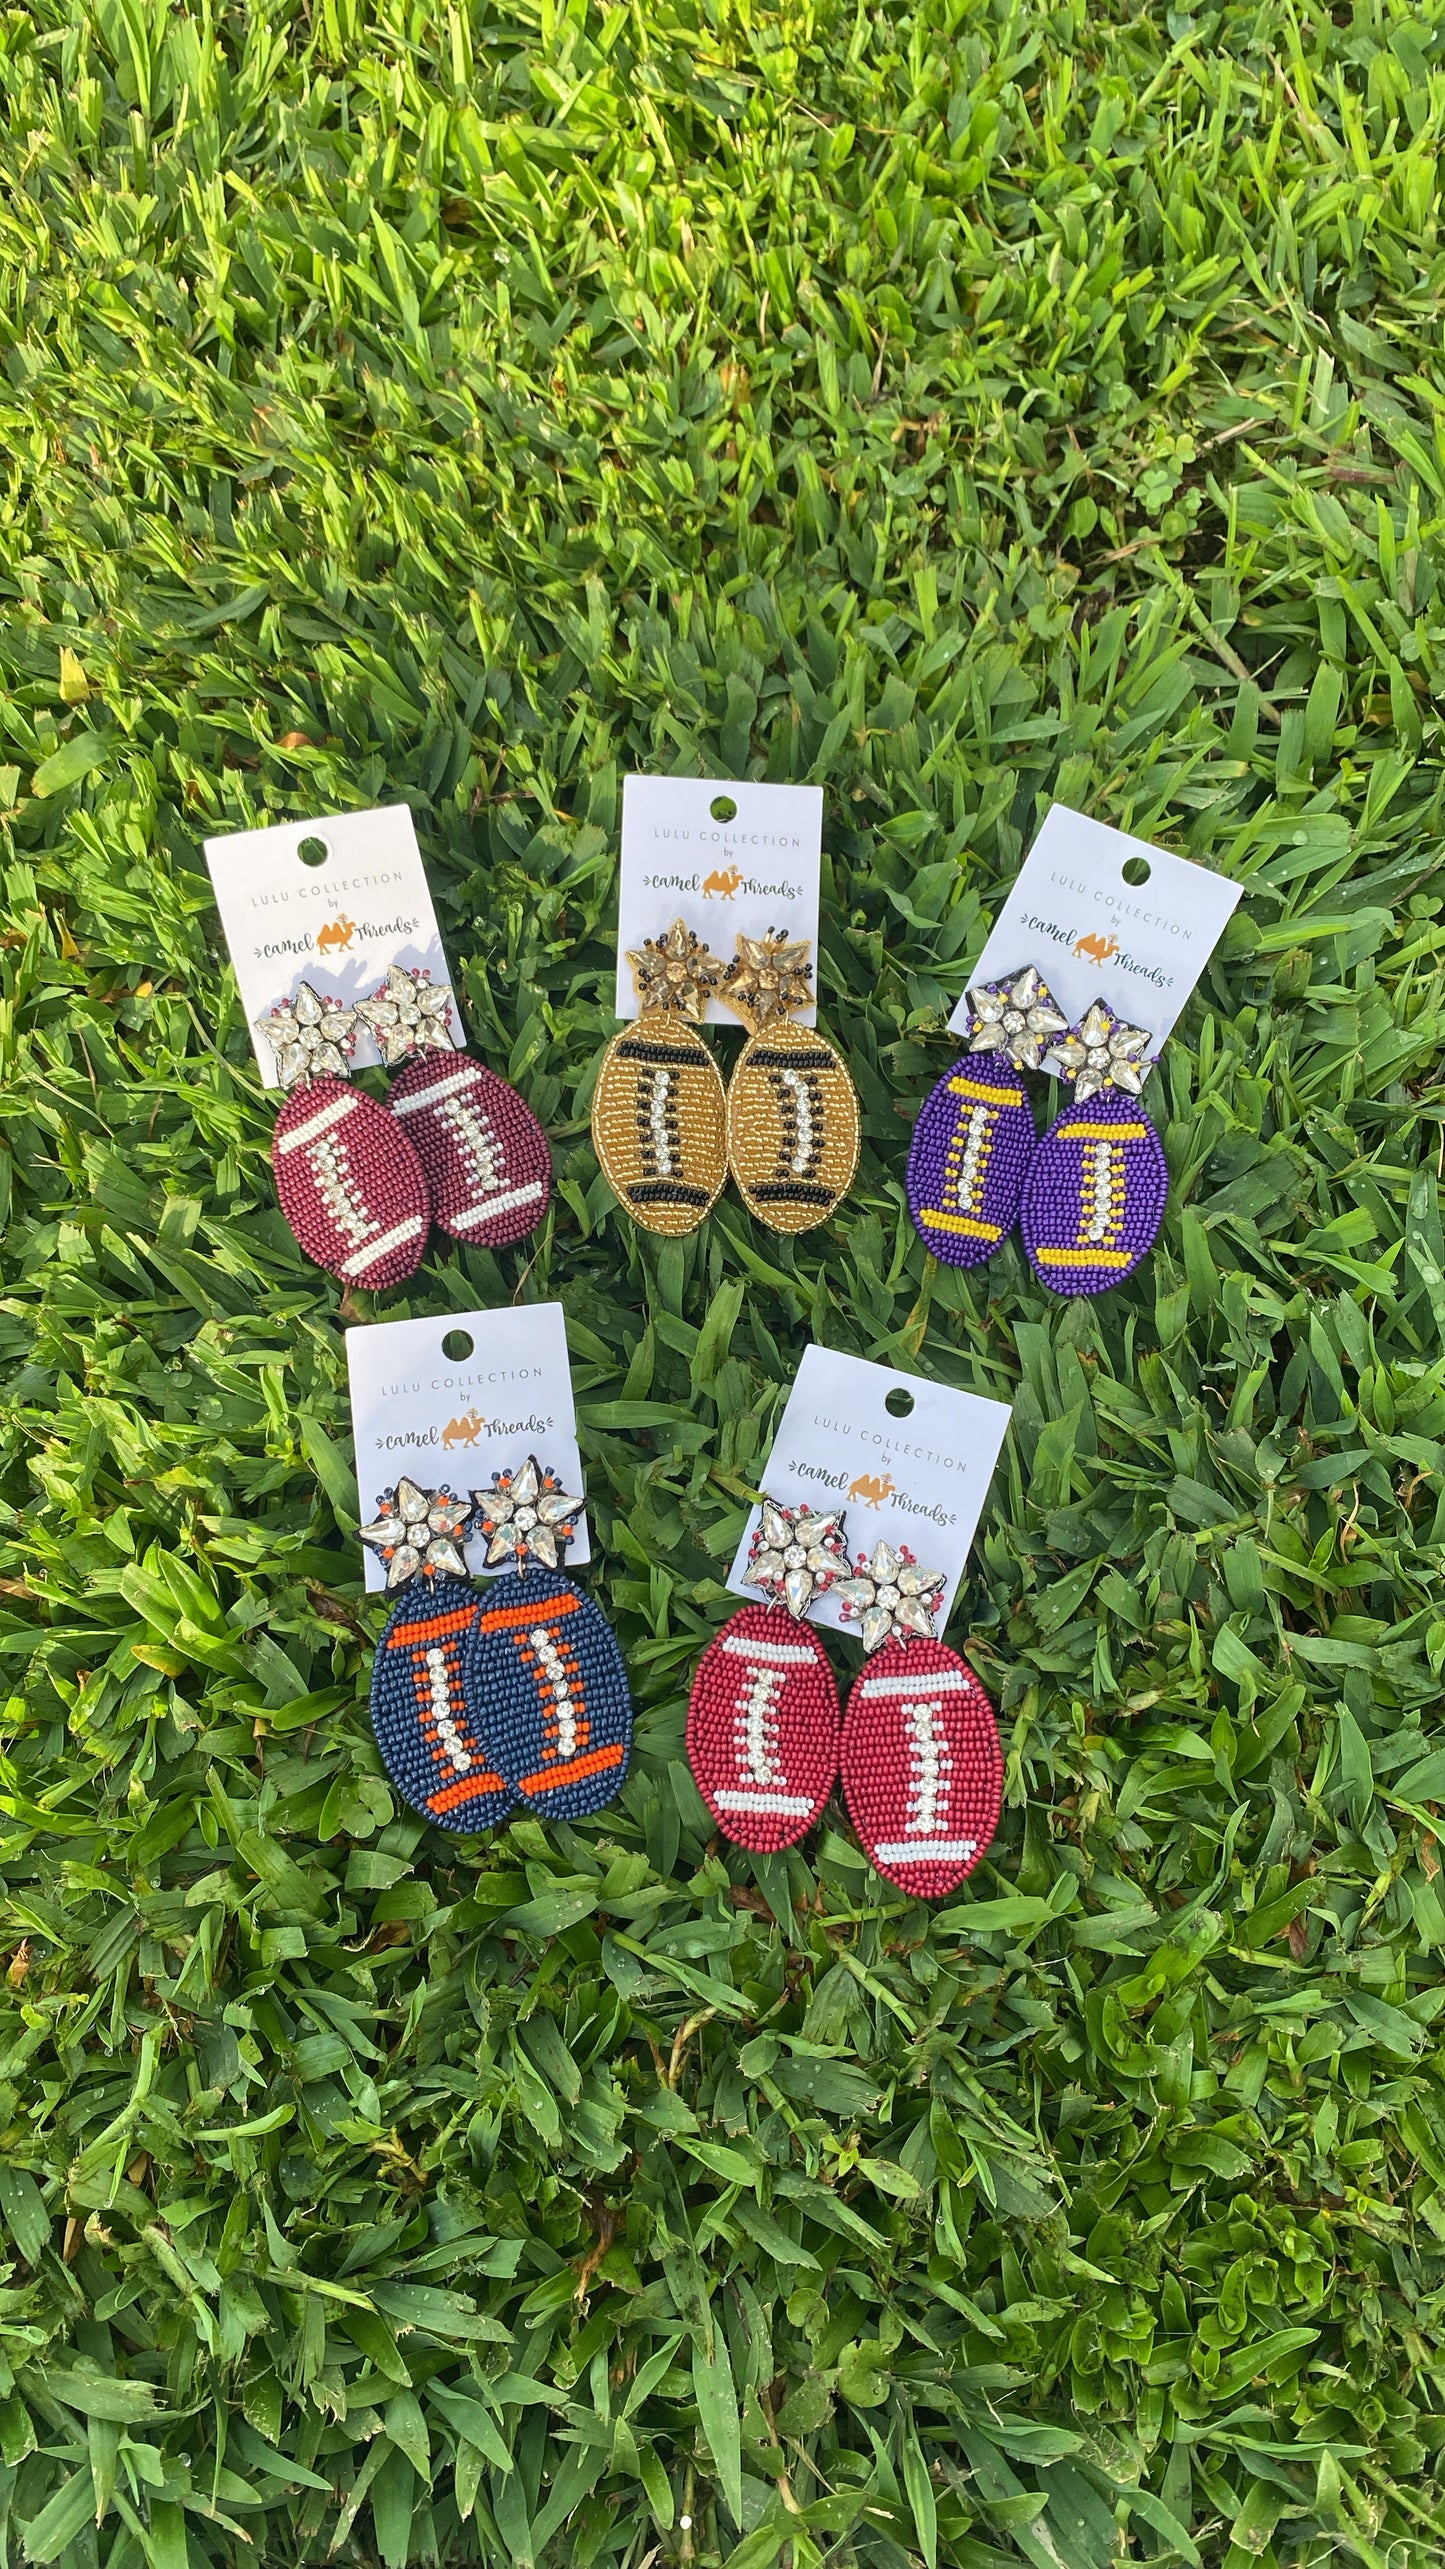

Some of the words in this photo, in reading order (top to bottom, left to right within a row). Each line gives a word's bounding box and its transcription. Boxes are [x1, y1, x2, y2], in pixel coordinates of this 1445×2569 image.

[654, 829, 690, 839] LULU
[699, 832, 800, 847] COLLECTION
[724, 847, 733, 857] by
[252, 892, 289, 907] LULU
[299, 872, 403, 898] COLLECTION
[741, 878, 796, 900] Threads
[328, 899, 338, 908] by
[1050, 872, 1087, 894] LULU
[1094, 891, 1192, 940] COLLECTION
[354, 916, 412, 941] Threads
[1110, 914, 1121, 927] by
[1114, 952, 1166, 988] Threads
[382, 1382, 420, 1396] LULU
[431, 1368, 542, 1389] COLLECTION
[460, 1392, 470, 1402] by
[484, 1414, 546, 1437] Threads
[814, 1415, 851, 1434] LULU
[860, 1430, 967, 1472] COLLECTION
[881, 1452, 892, 1465] by
[891, 1492, 948, 1526] Threads
